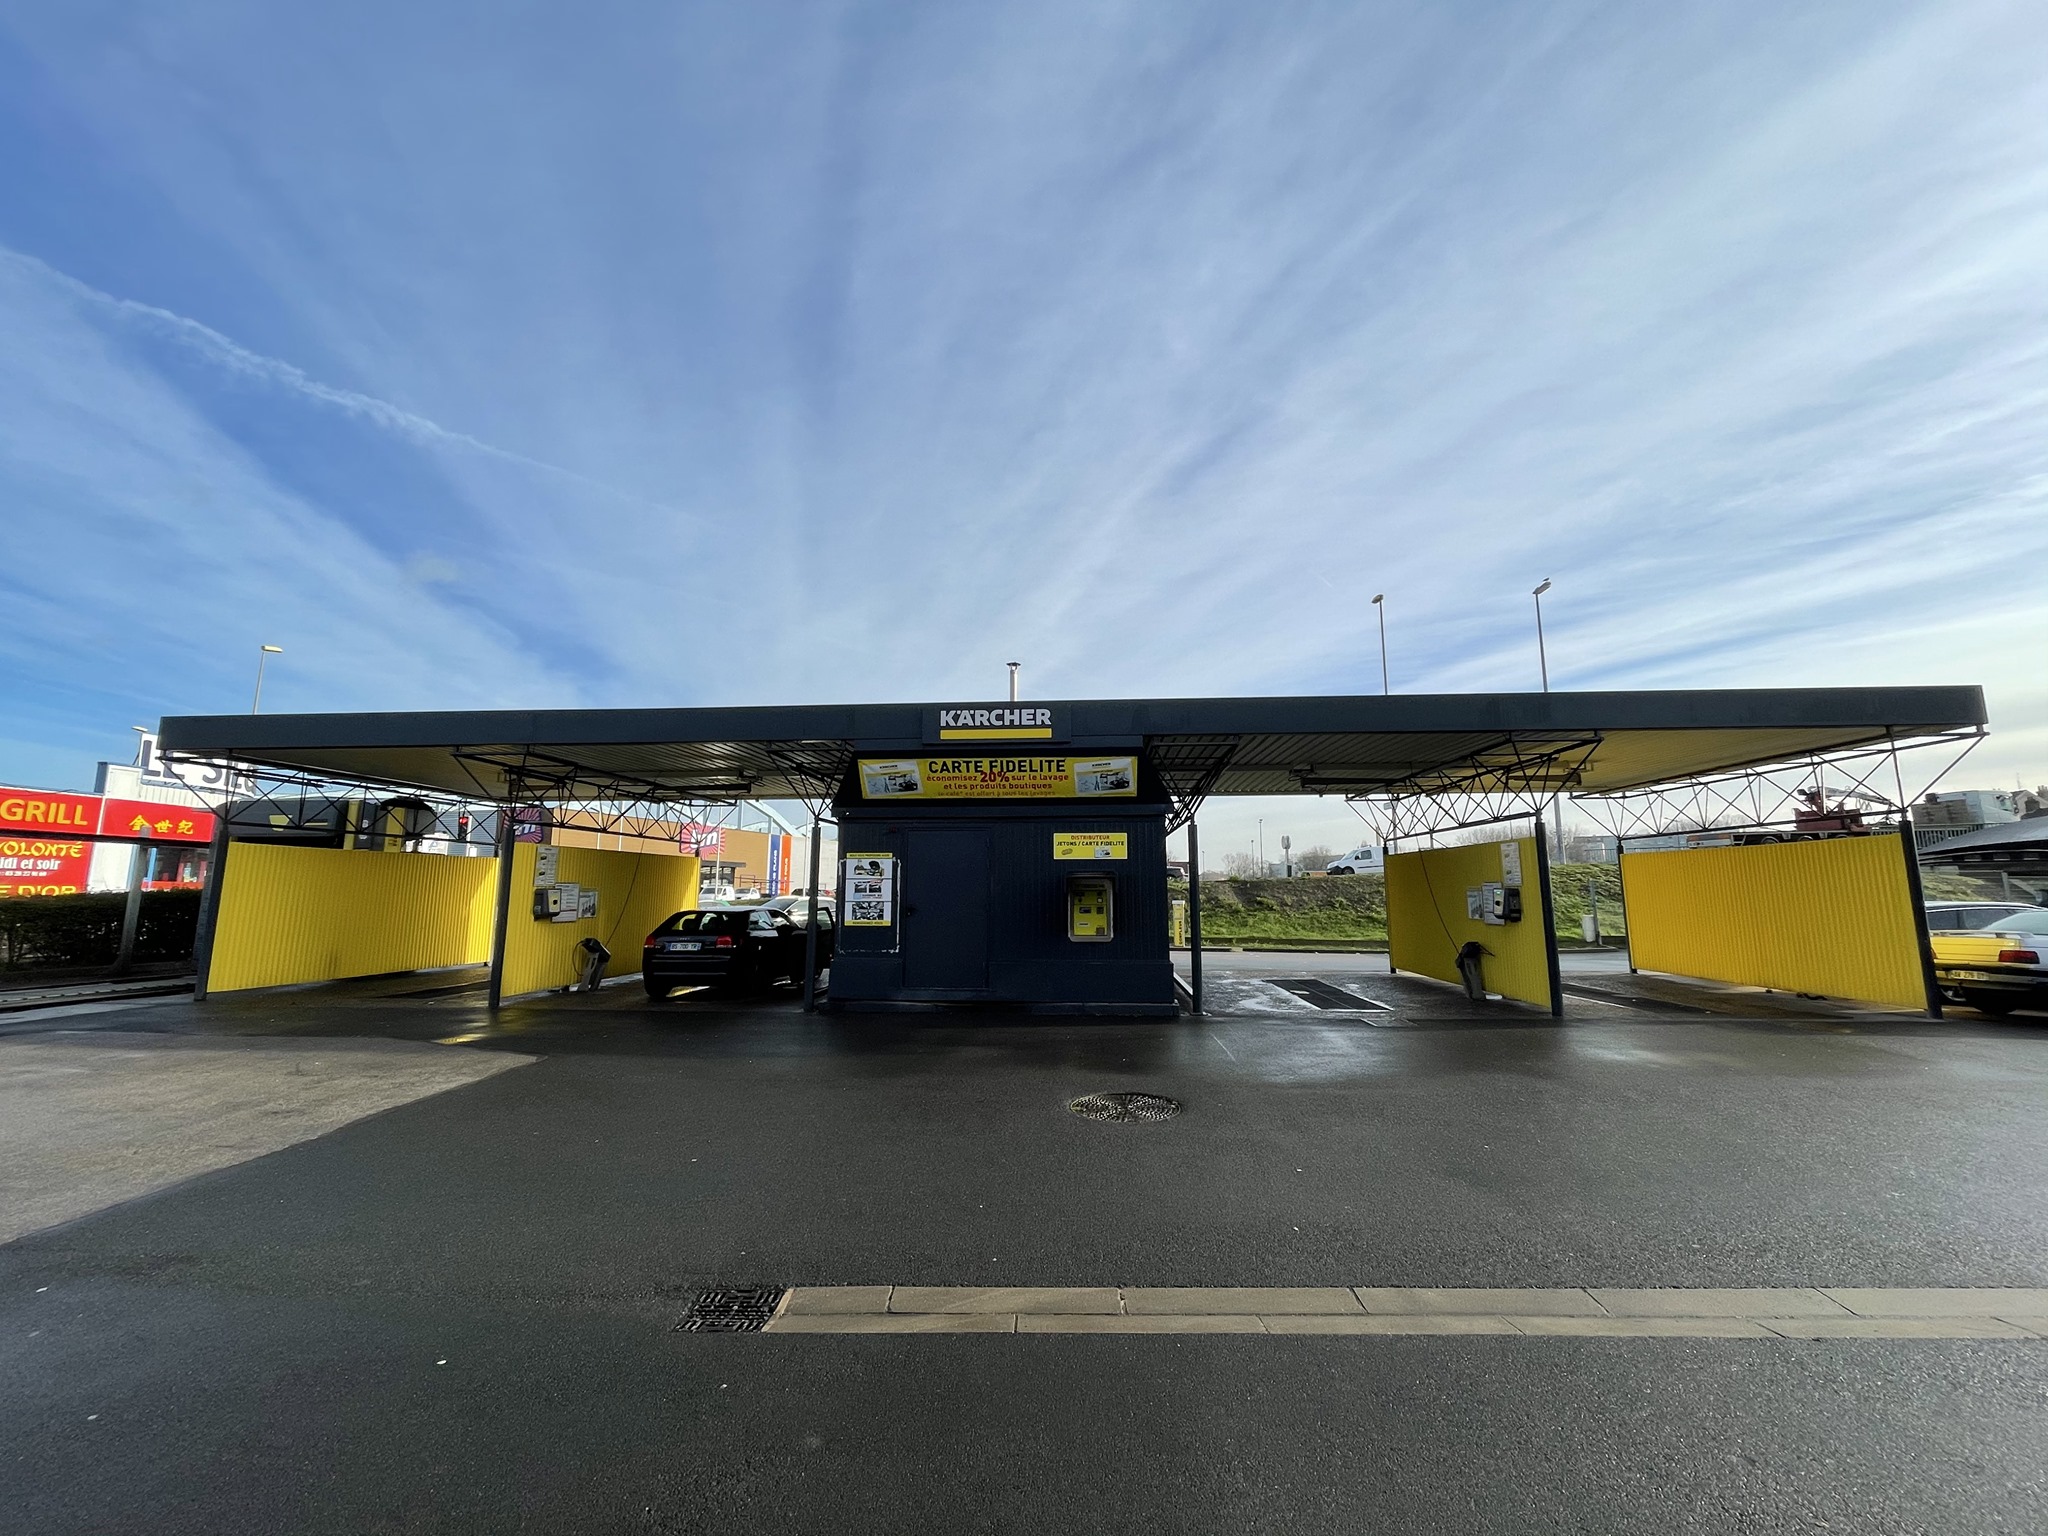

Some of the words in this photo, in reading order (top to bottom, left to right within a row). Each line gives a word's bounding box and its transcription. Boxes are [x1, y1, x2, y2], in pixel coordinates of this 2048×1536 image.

[940, 708, 1052, 726] KÄRCHER
[928, 760, 983, 773] CARTE
[989, 759, 1066, 773] FIDELITE
[926, 774, 978, 782] économisez
[980, 771, 1010, 782] 20%
[1029, 773, 1037, 781] le
[1040, 773, 1069, 782] lavage
[943, 782, 953, 790] et
[955, 782, 968, 790] les
[970, 782, 1006, 791] produits
[1008, 782, 1053, 791] boutiques
[0, 798, 88, 826] GRILL
[20, 858, 34, 869] et
[36, 859, 61, 870] soir
